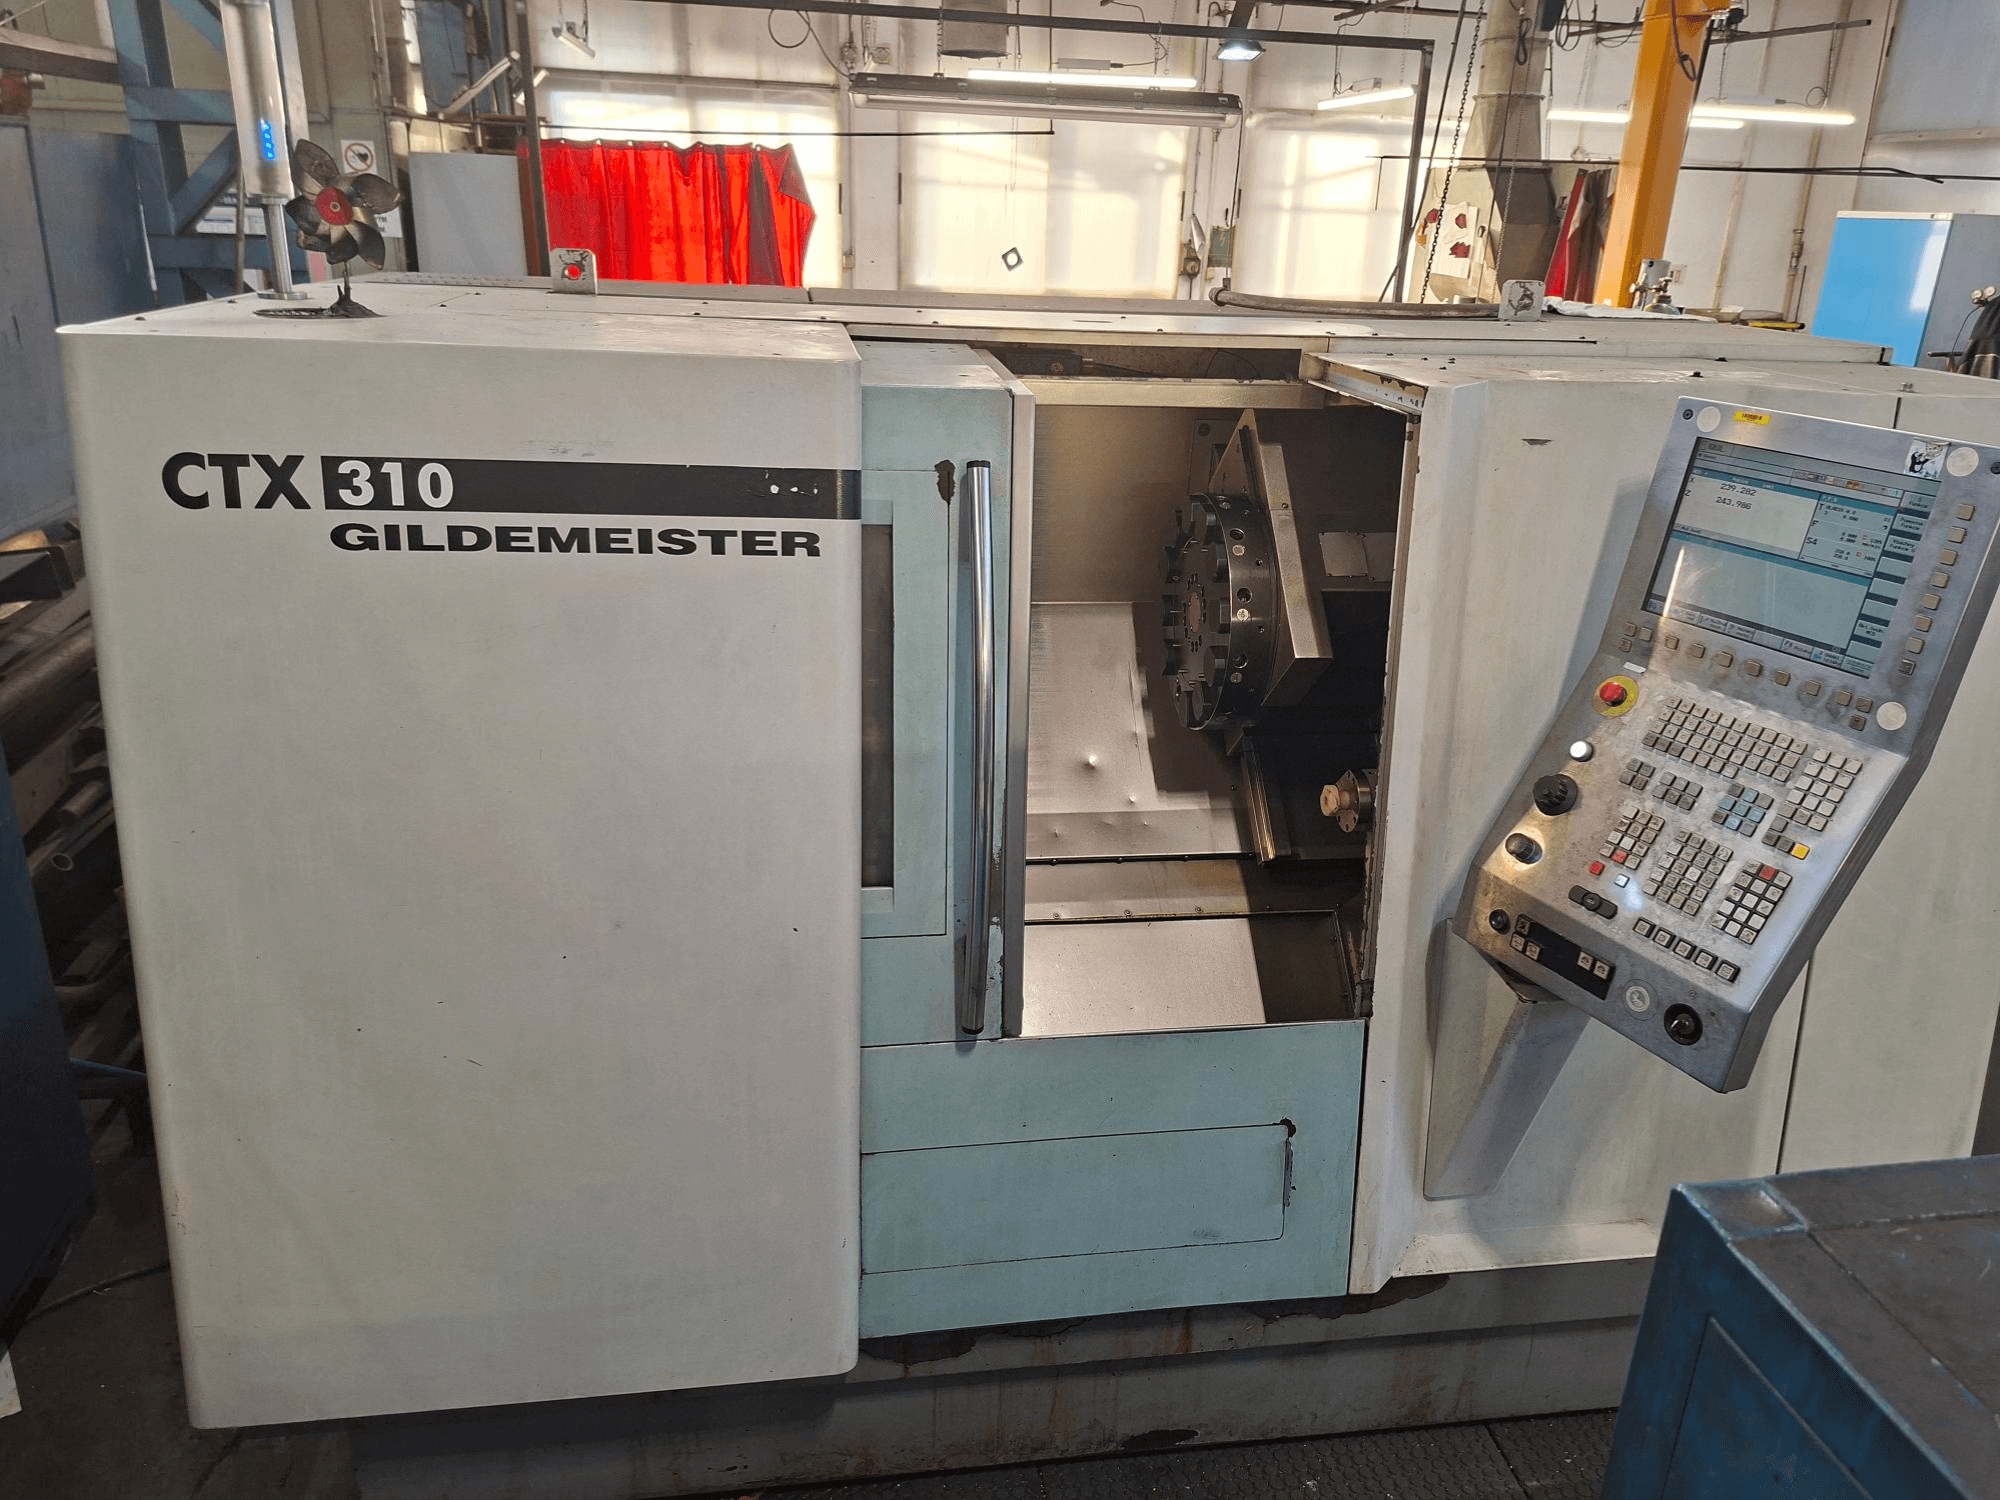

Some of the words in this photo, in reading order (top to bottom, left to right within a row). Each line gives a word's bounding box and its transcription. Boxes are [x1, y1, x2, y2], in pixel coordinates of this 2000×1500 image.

[161, 452, 311, 510] CTX
[336, 460, 454, 508] 310
[1720, 483, 1757, 497] 239.282
[1715, 496, 1753, 510] 243.986
[329, 523, 821, 557] GILDEMEISTER
